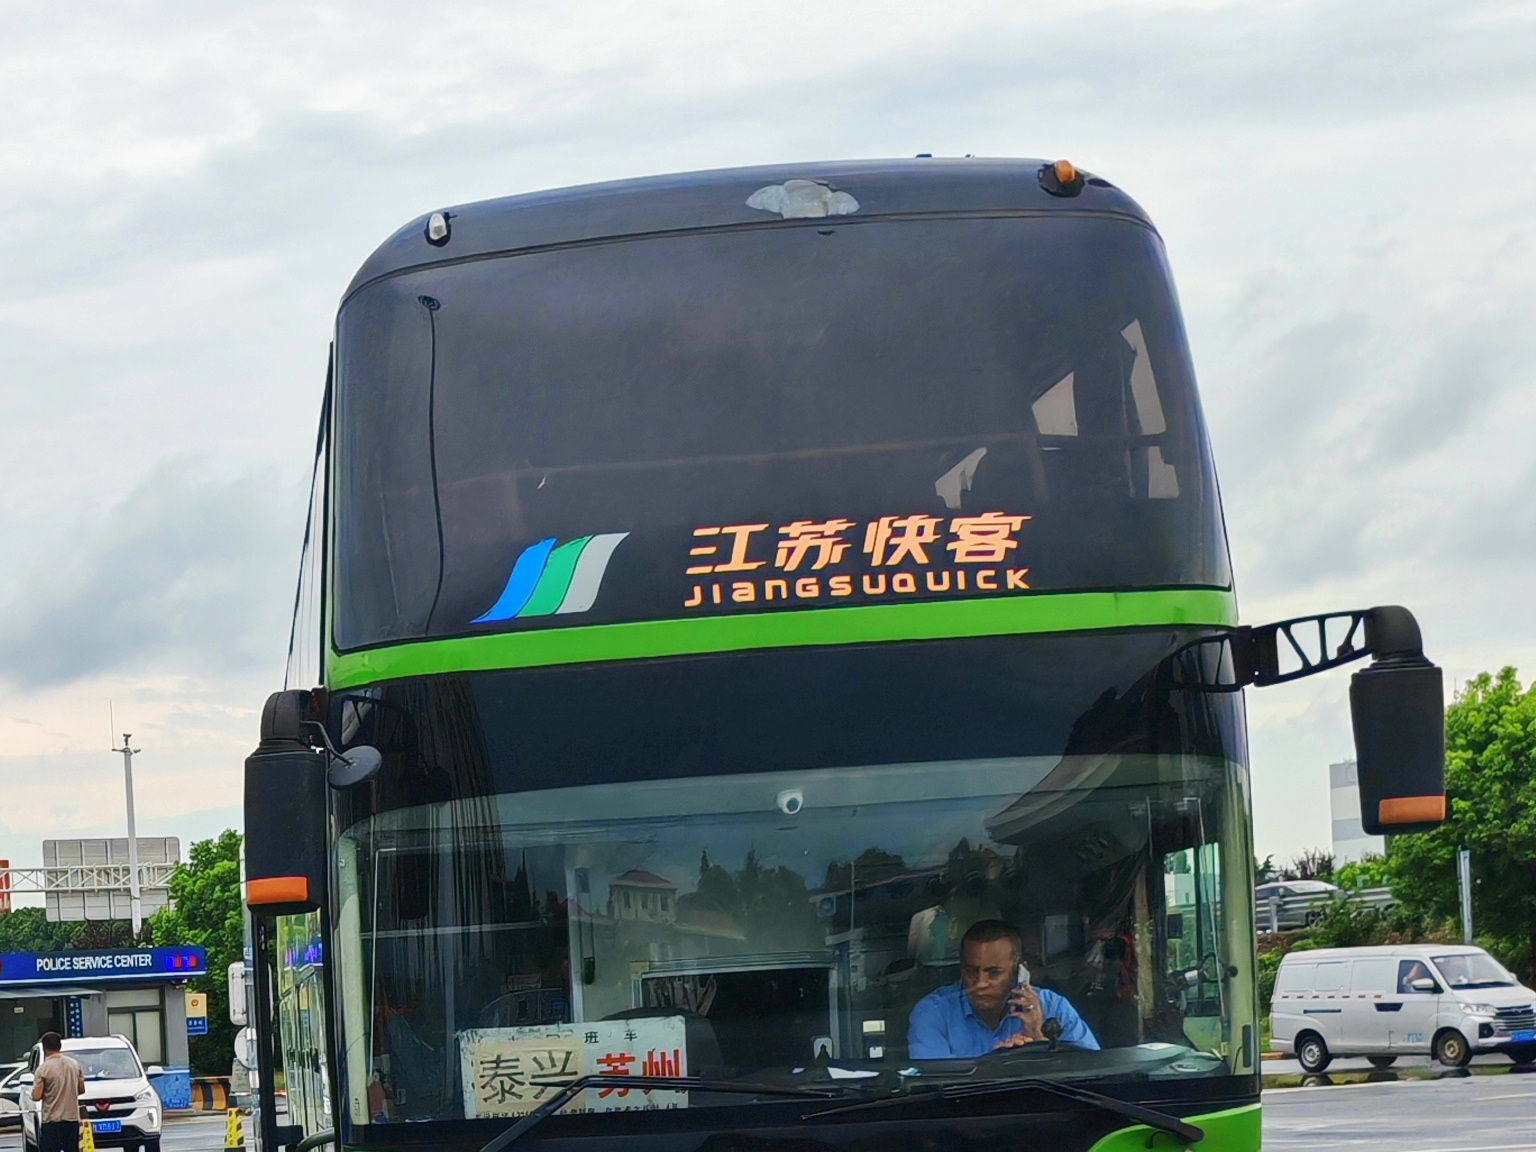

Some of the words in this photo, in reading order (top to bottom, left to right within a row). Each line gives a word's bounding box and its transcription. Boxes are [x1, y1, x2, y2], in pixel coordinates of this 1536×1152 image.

[686, 511, 1033, 575] 江苏快客
[36, 958, 71, 971] POLICE
[72, 956, 113, 970] SERVICE
[114, 954, 152, 968] CENTER
[480, 1050, 578, 1104] 泰兴
